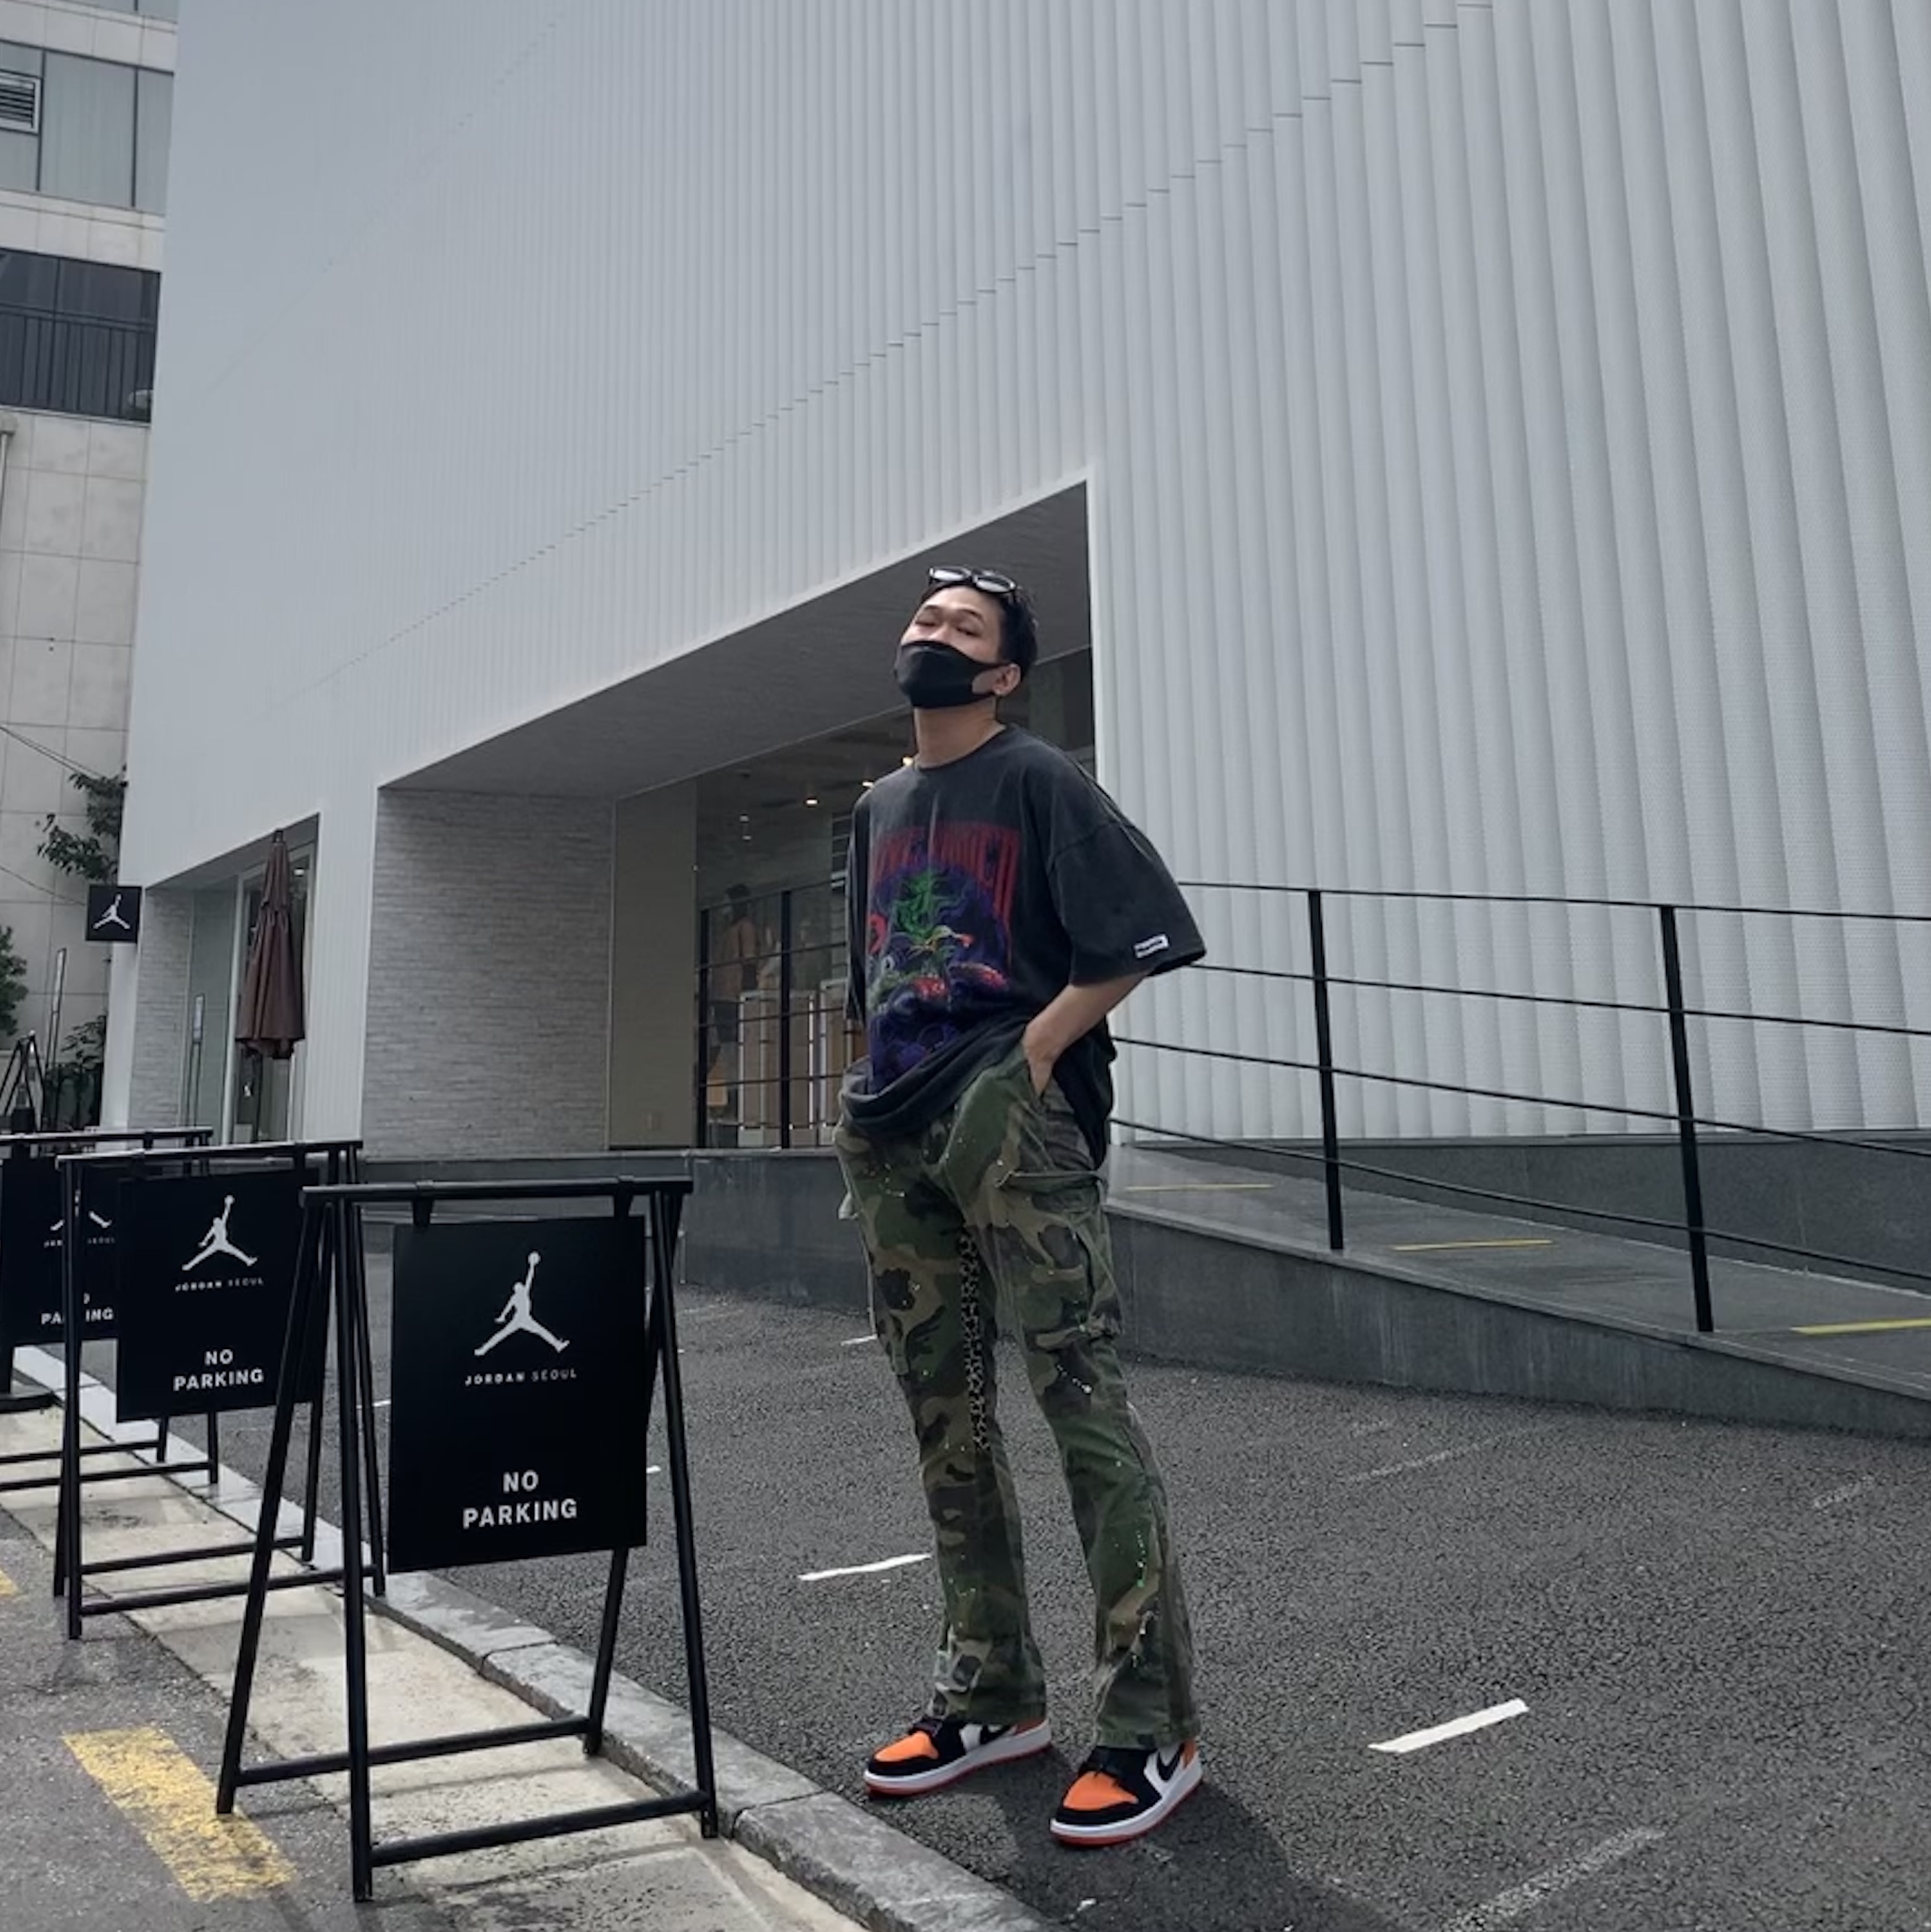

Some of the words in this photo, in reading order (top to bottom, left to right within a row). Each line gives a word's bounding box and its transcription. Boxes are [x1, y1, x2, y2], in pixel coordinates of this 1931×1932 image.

[204, 1348, 233, 1366] NO
[173, 1368, 264, 1392] PARKING
[464, 1371, 525, 1387] JORDAN
[531, 1368, 577, 1382] SEOUL
[502, 1469, 539, 1492] NO
[463, 1498, 578, 1529] PARKING
